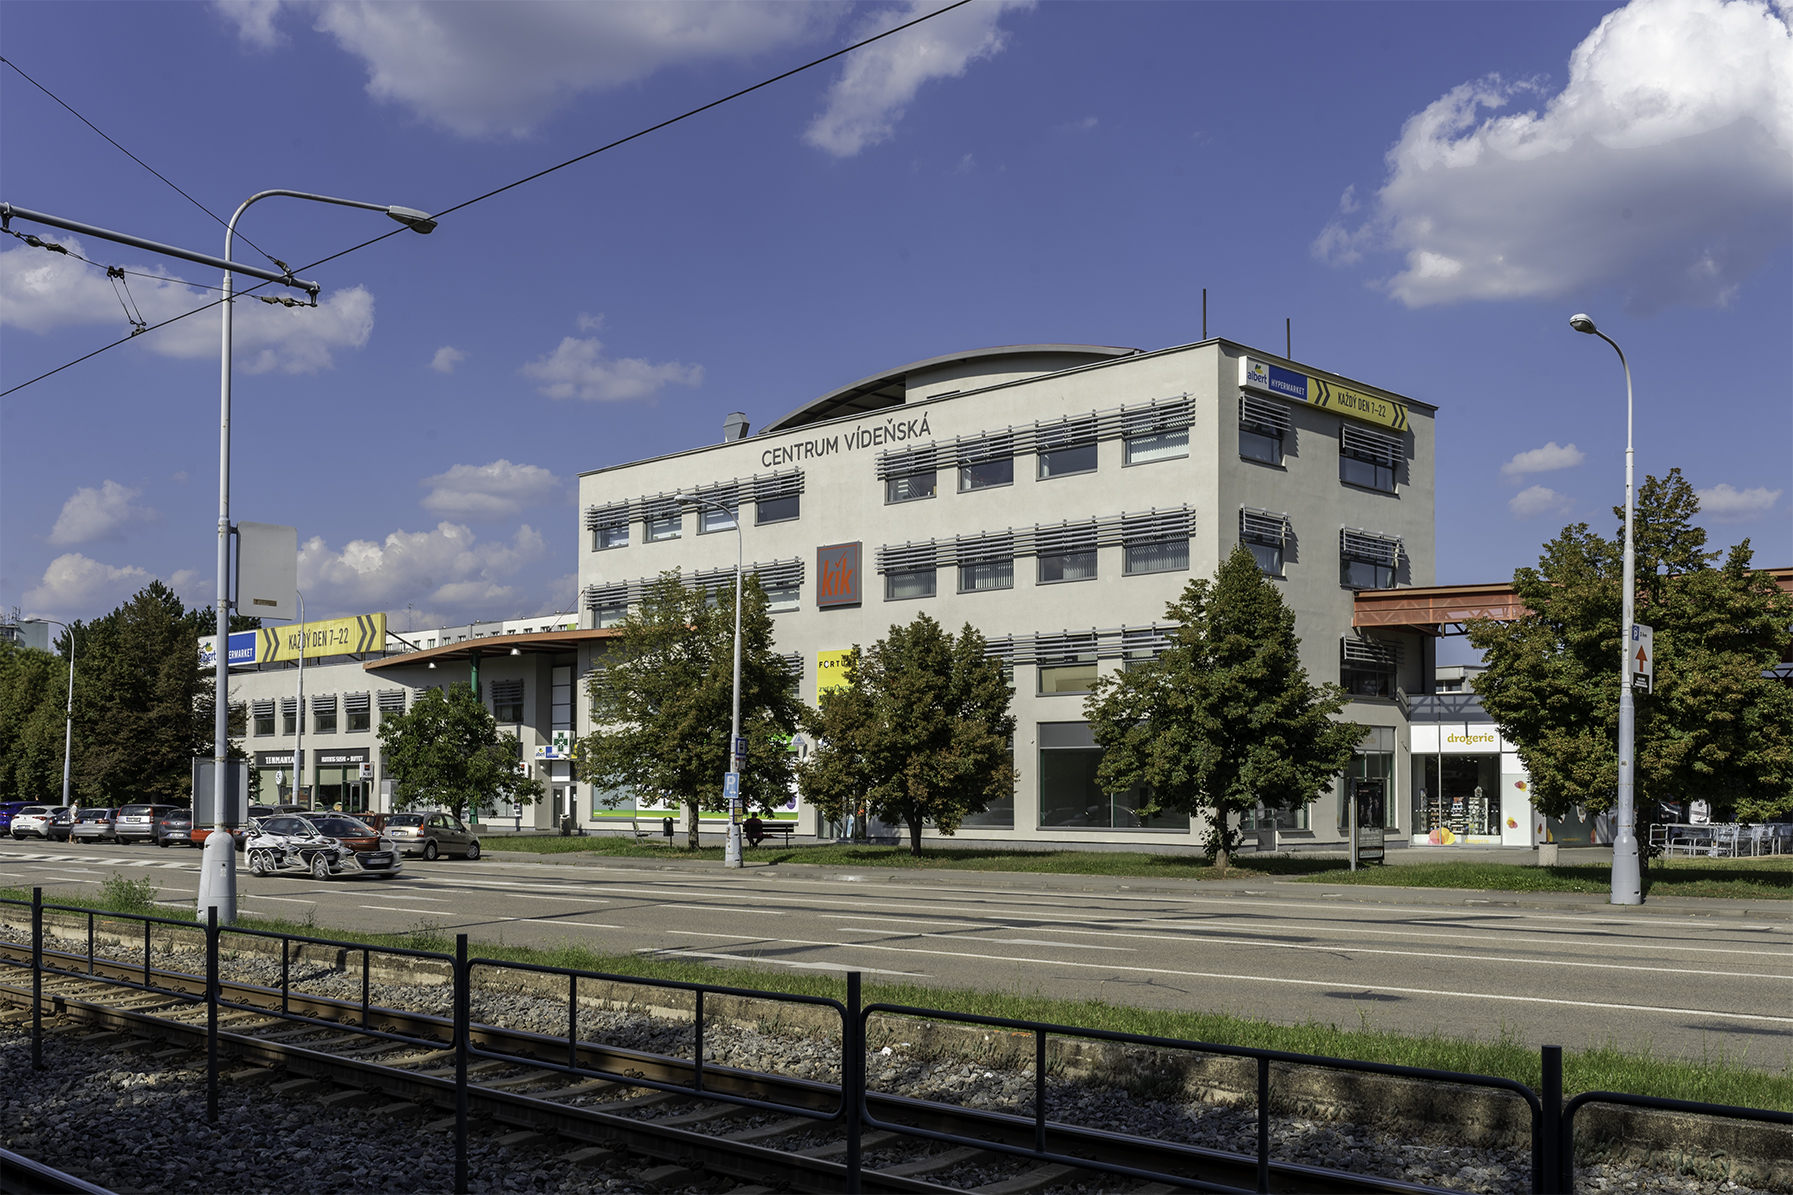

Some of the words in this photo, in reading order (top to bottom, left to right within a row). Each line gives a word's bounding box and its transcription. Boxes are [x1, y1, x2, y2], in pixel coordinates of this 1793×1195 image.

[1247, 370, 1268, 385] albert
[1271, 378, 1305, 396] HYPERMARKET
[1338, 391, 1357, 409] KAŽDÝ
[1358, 397, 1370, 413] DEN
[761, 436, 838, 467] CENTRUM
[844, 411, 931, 451] VÍDEŇSKÁ
[288, 628, 311, 650] KAŽDÝ
[312, 630, 328, 648] DEN
[199, 649, 217, 663] bert
[228, 647, 253, 660] ERMARKET
[818, 660, 848, 668] FORTU
[1447, 732, 1495, 746] drogerie
[726, 775, 736, 790] P
[1464, 837, 1490, 845] drogerie
